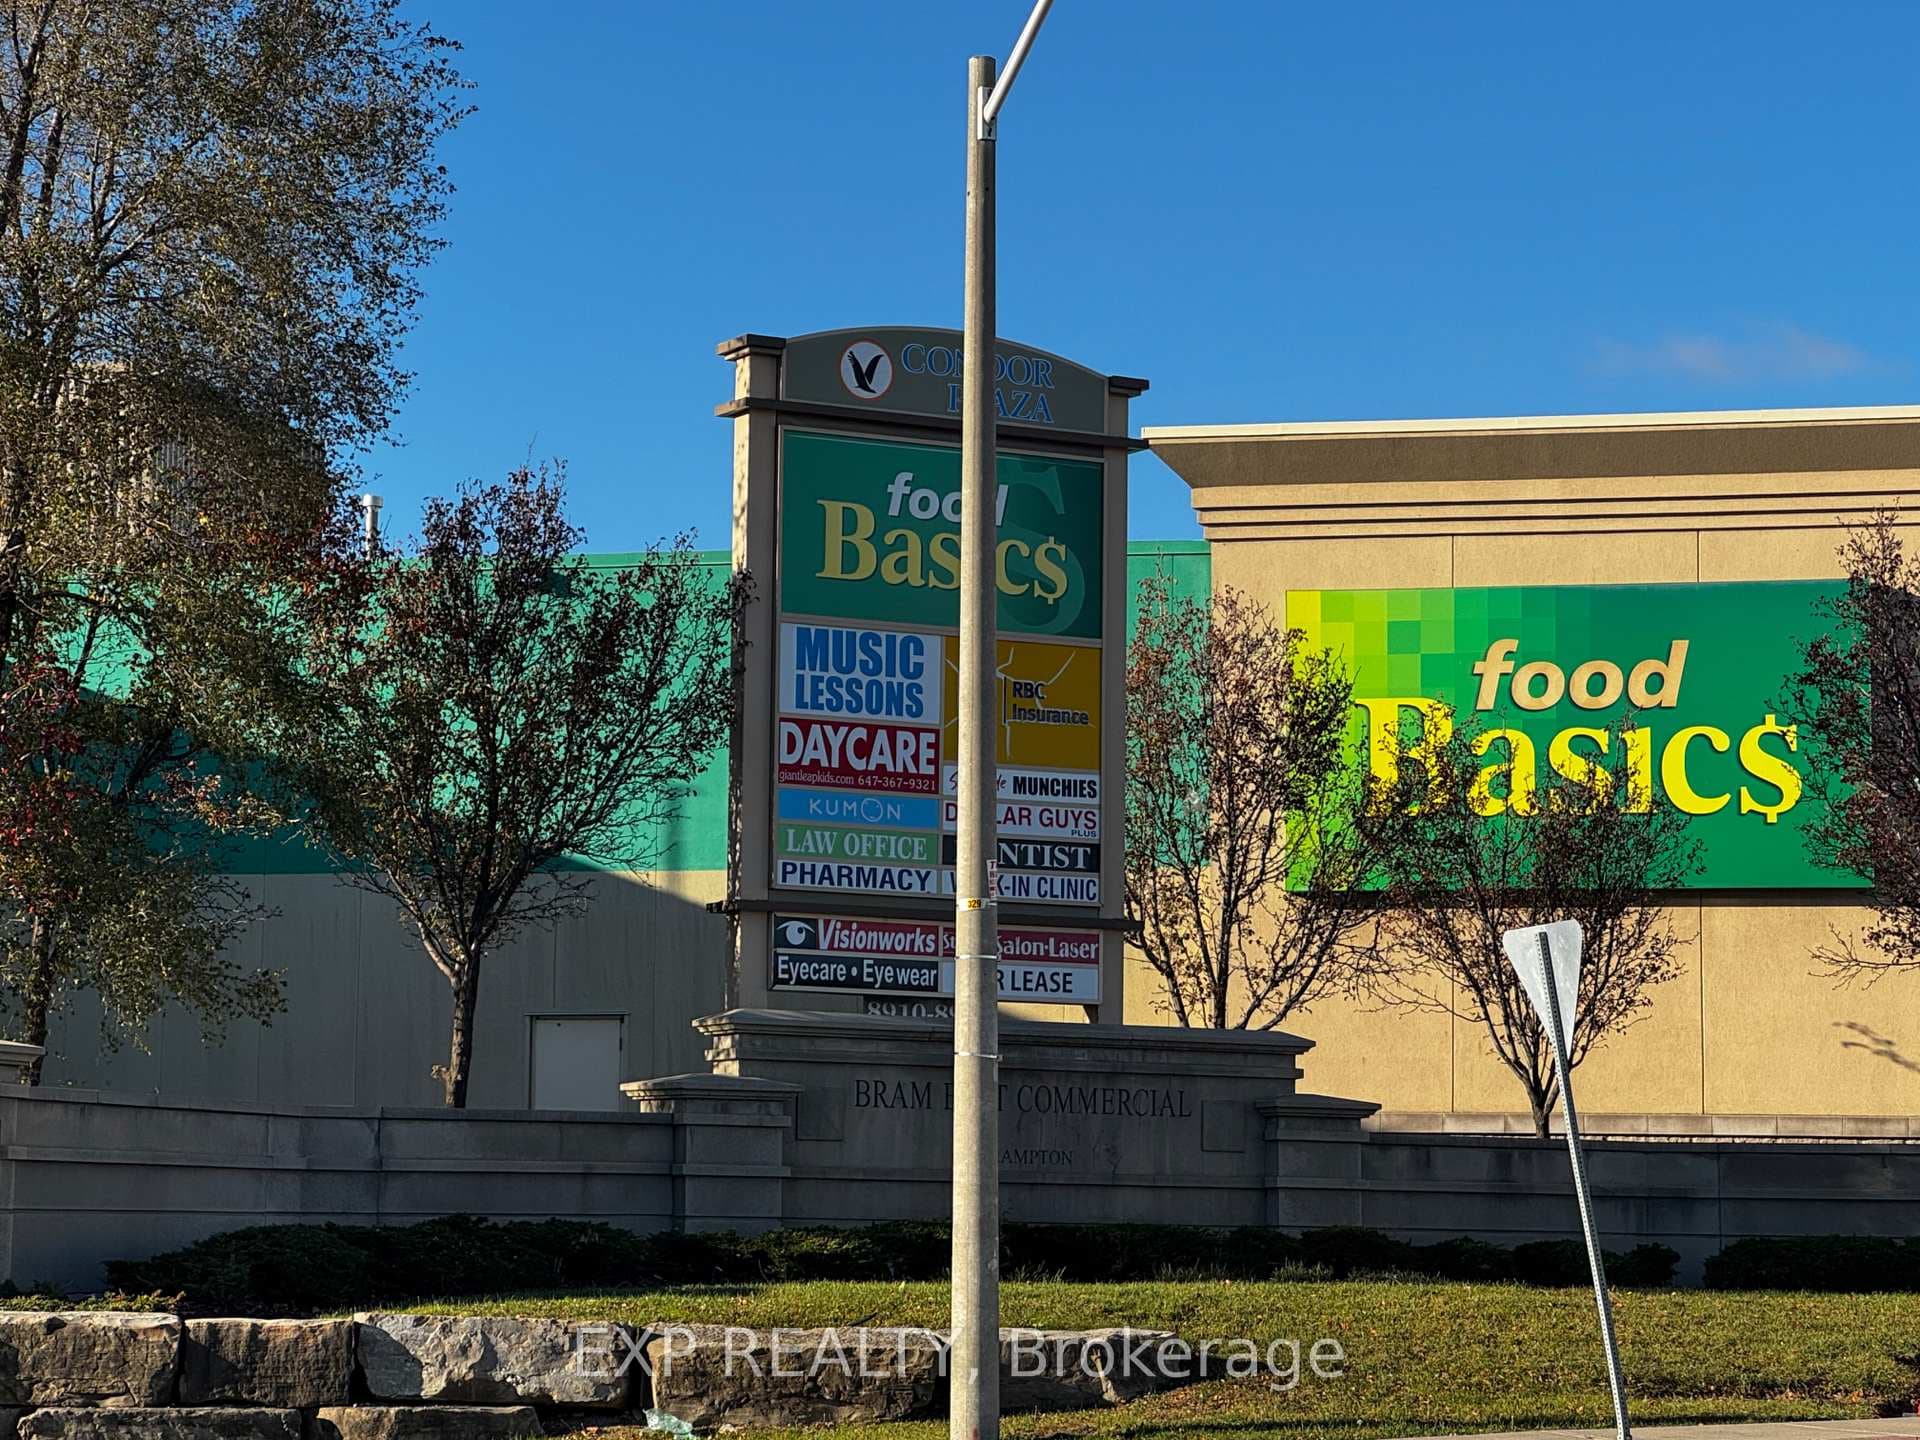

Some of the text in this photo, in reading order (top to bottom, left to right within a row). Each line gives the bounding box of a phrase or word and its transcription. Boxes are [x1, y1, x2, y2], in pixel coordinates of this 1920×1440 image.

[815, 499, 1067, 604] Basc$
[796, 626, 924, 680] MUSIC
[1473, 639, 1690, 711] food
[795, 673, 924, 718] LESSONS
[1012, 681, 1046, 699] RBC
[1012, 703, 1089, 725] Insurance
[779, 721, 936, 775] DAYCARE
[857, 775, 936, 791] 647-367-9321
[1012, 775, 1098, 799] MUNCHIES
[809, 798, 901, 822] KUMON
[1039, 808, 1097, 830] GUYS
[786, 829, 928, 860] LAW OFFICE
[1071, 829, 1097, 838] PLUS
[781, 861, 932, 891] PHARMACY
[1037, 876, 1097, 901] CLINIC
[817, 919, 936, 953] Visionworks
[777, 955, 846, 984] Eyecare
[1011, 970, 1073, 993] LEASE
[855, 1079, 931, 1109] BRAM
[1017, 1084, 1192, 1117] COMMERCIAL
